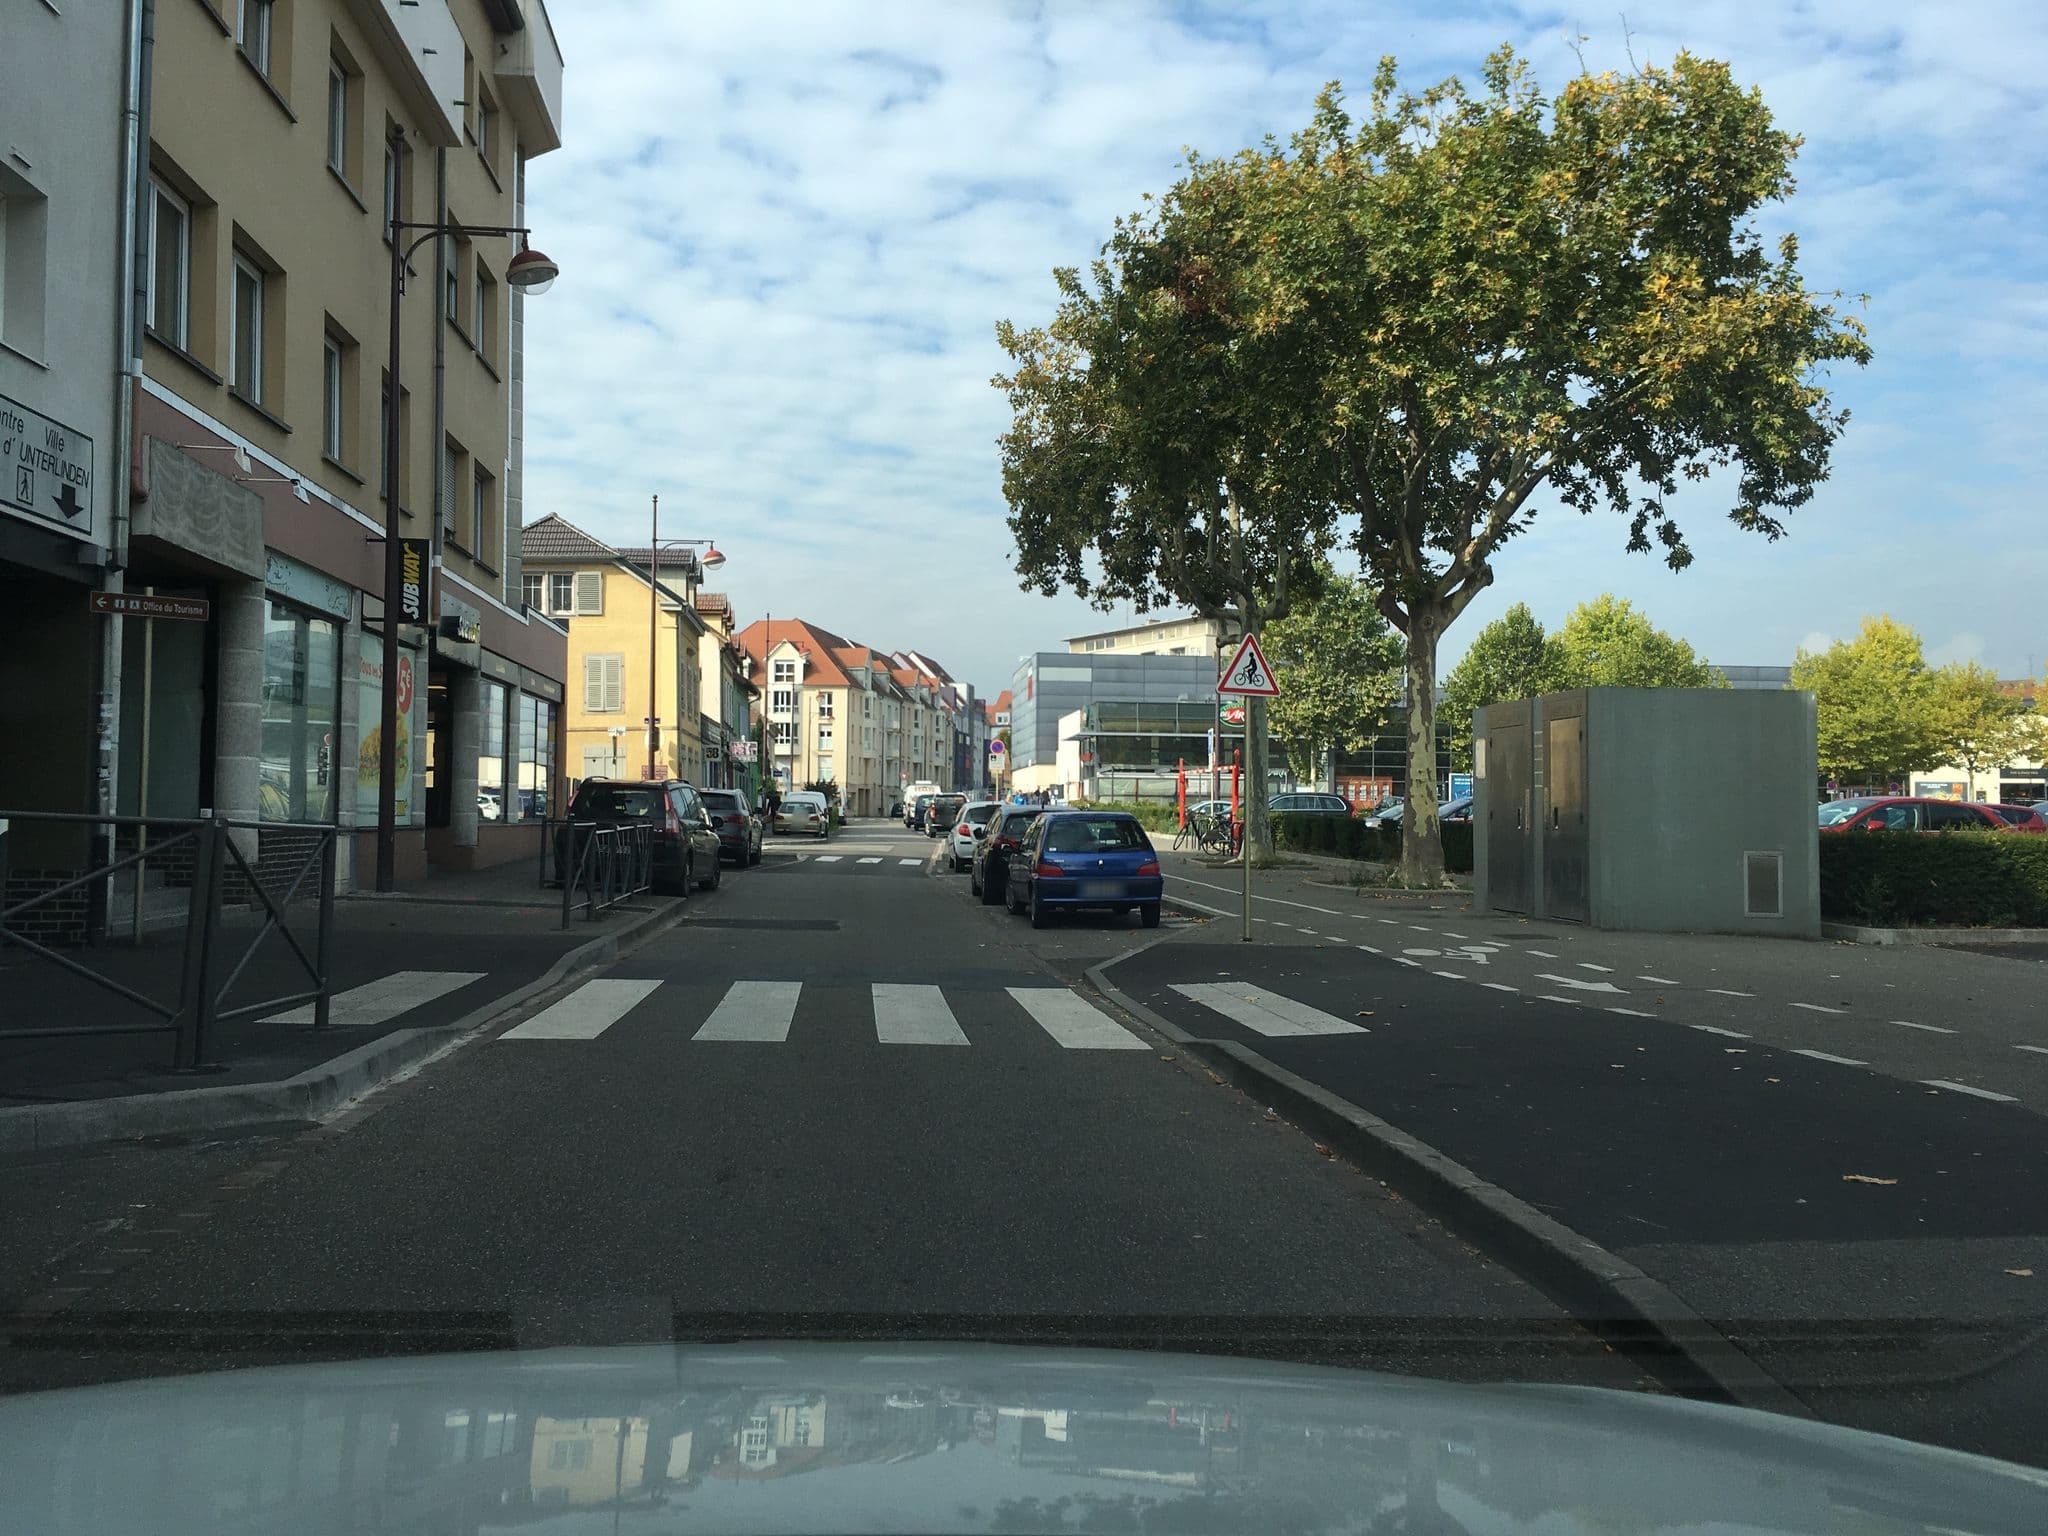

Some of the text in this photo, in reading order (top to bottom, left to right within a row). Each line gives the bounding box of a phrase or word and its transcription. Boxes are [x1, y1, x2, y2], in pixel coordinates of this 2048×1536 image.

[0, 410, 65, 452] ntre Ville
[19, 441, 90, 489] UNTERLINDEN
[402, 542, 421, 620] SUBWAY
[143, 600, 203, 616] Office du Tourisme
